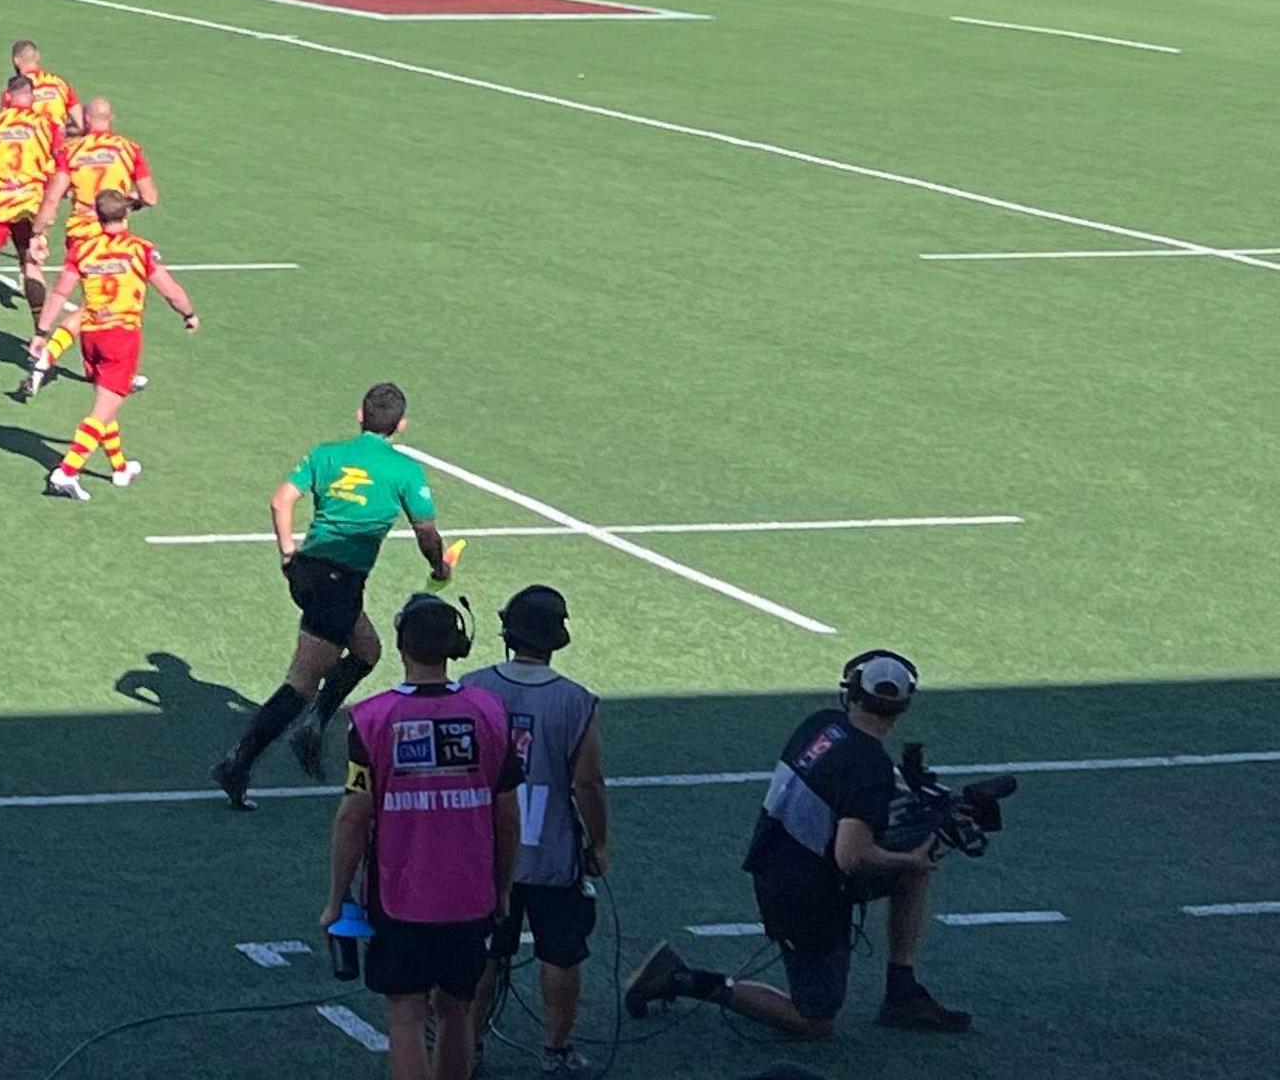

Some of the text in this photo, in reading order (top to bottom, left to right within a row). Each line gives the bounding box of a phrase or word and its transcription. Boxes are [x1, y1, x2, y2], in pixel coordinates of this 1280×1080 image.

[7, 141, 23, 172] 3
[91, 165, 109, 196] 7
[100, 274, 119, 306] 9
[439, 723, 475, 736] TOP
[442, 744, 474, 762] 14
